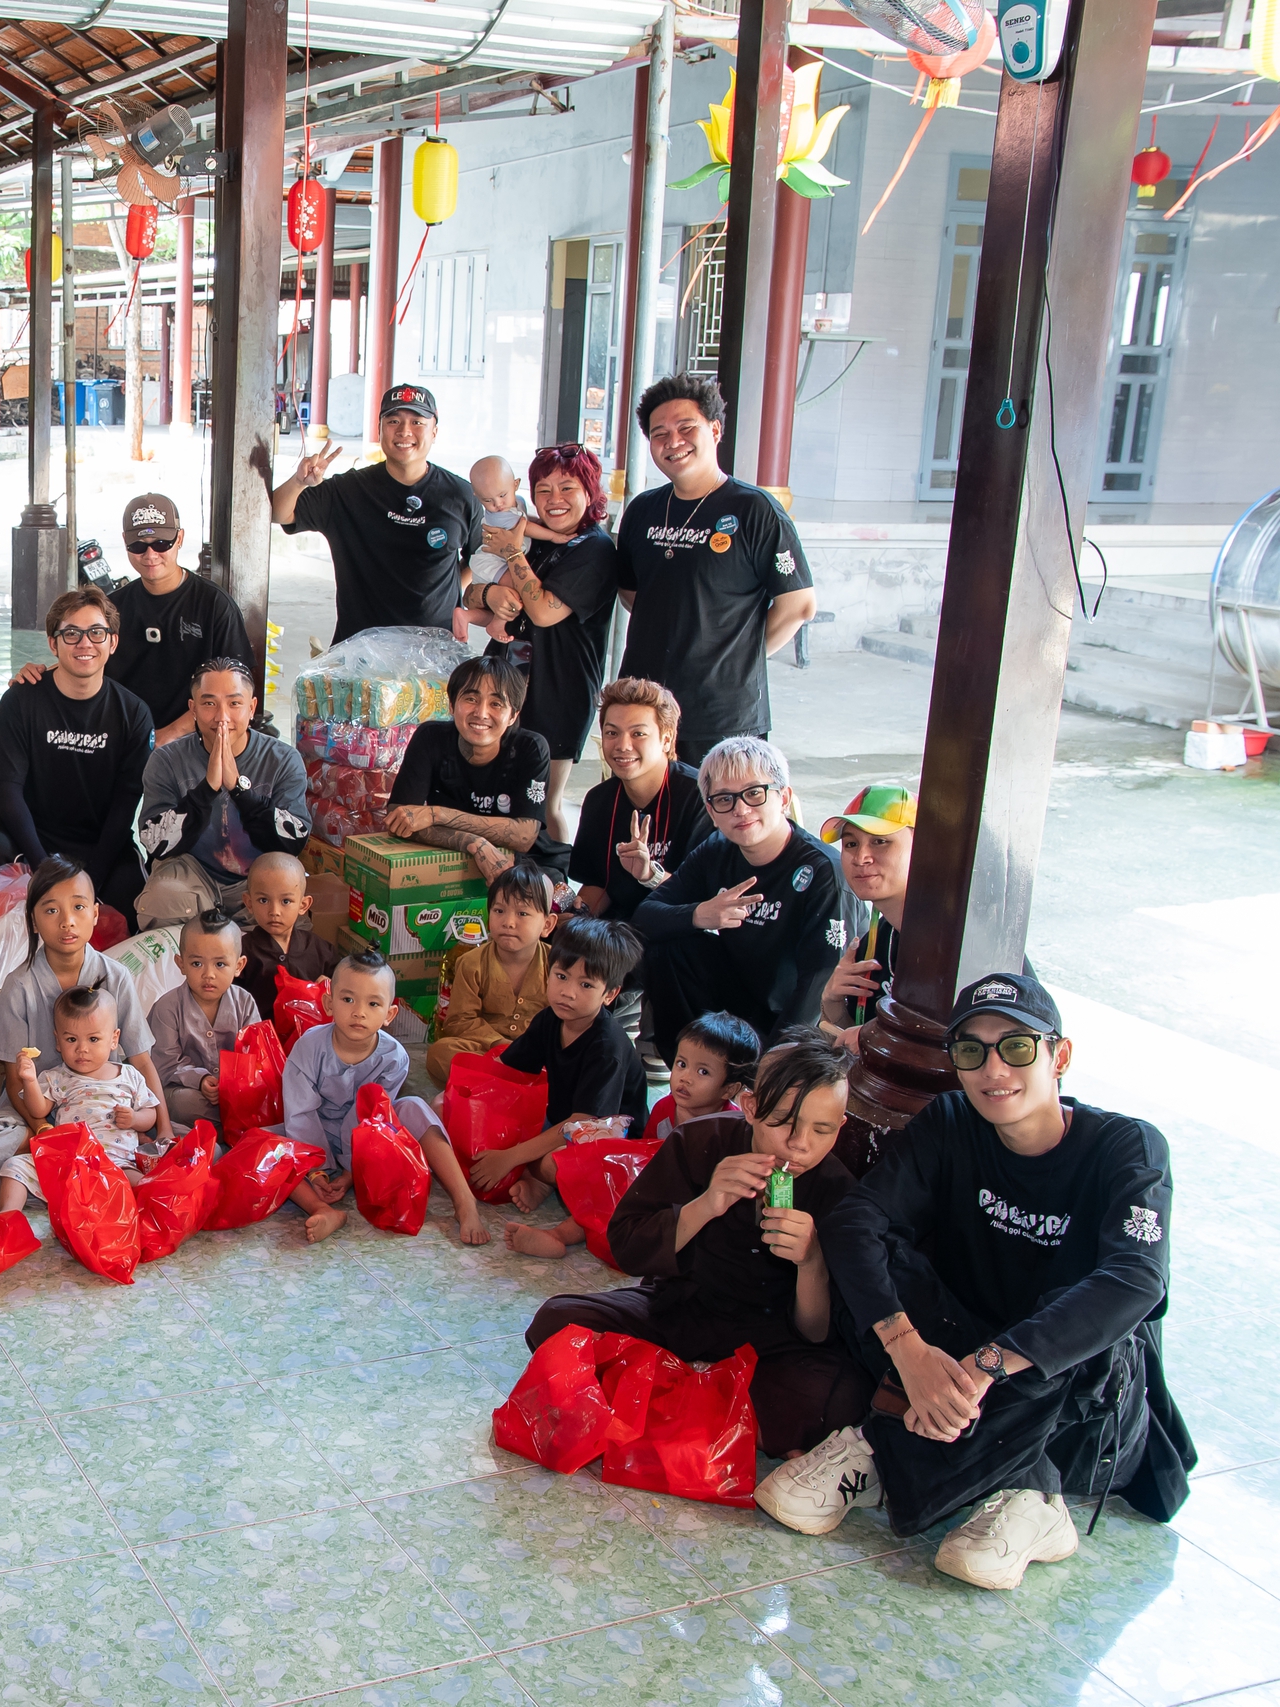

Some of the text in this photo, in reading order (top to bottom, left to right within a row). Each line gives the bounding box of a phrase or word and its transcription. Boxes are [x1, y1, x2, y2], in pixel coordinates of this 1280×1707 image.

[1005, 15, 1031, 27] SENKO
[368, 908, 386, 929] MILO
[418, 911, 440, 922] MILO
[1008, 1227, 1021, 1236] gọi
[836, 1468, 869, 1506] NY
